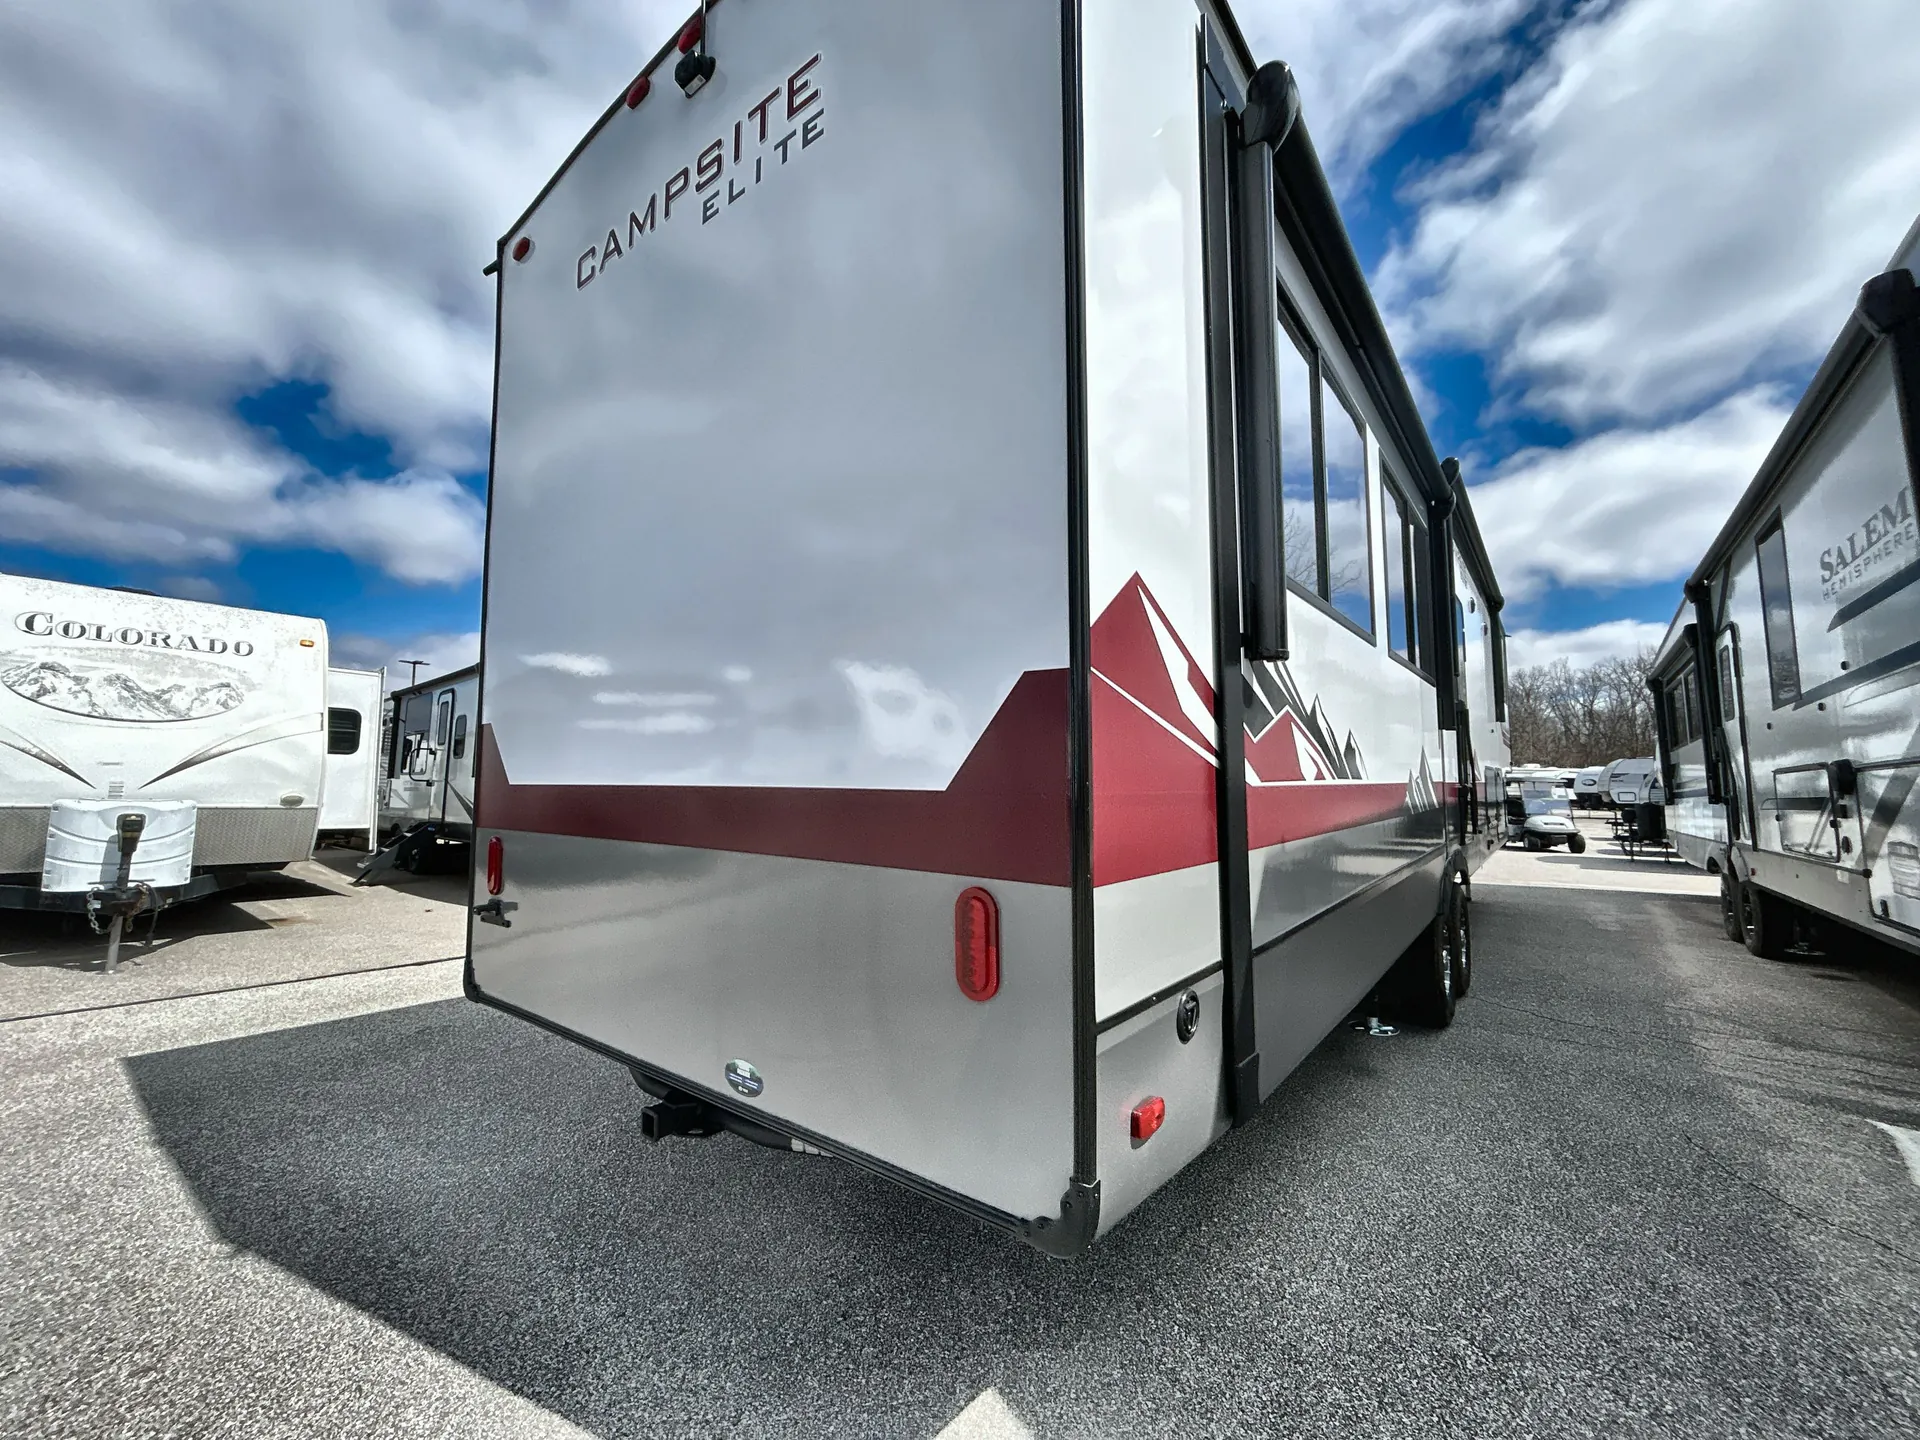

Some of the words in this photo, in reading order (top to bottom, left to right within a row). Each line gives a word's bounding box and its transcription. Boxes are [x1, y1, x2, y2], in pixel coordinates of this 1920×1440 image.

[577, 52, 820, 290] CAMPSITE
[702, 107, 824, 225] ELITE
[1819, 486, 1911, 585] SALEM
[1821, 522, 1914, 601] HEMISPHERE
[14, 610, 254, 657] COLORADO
